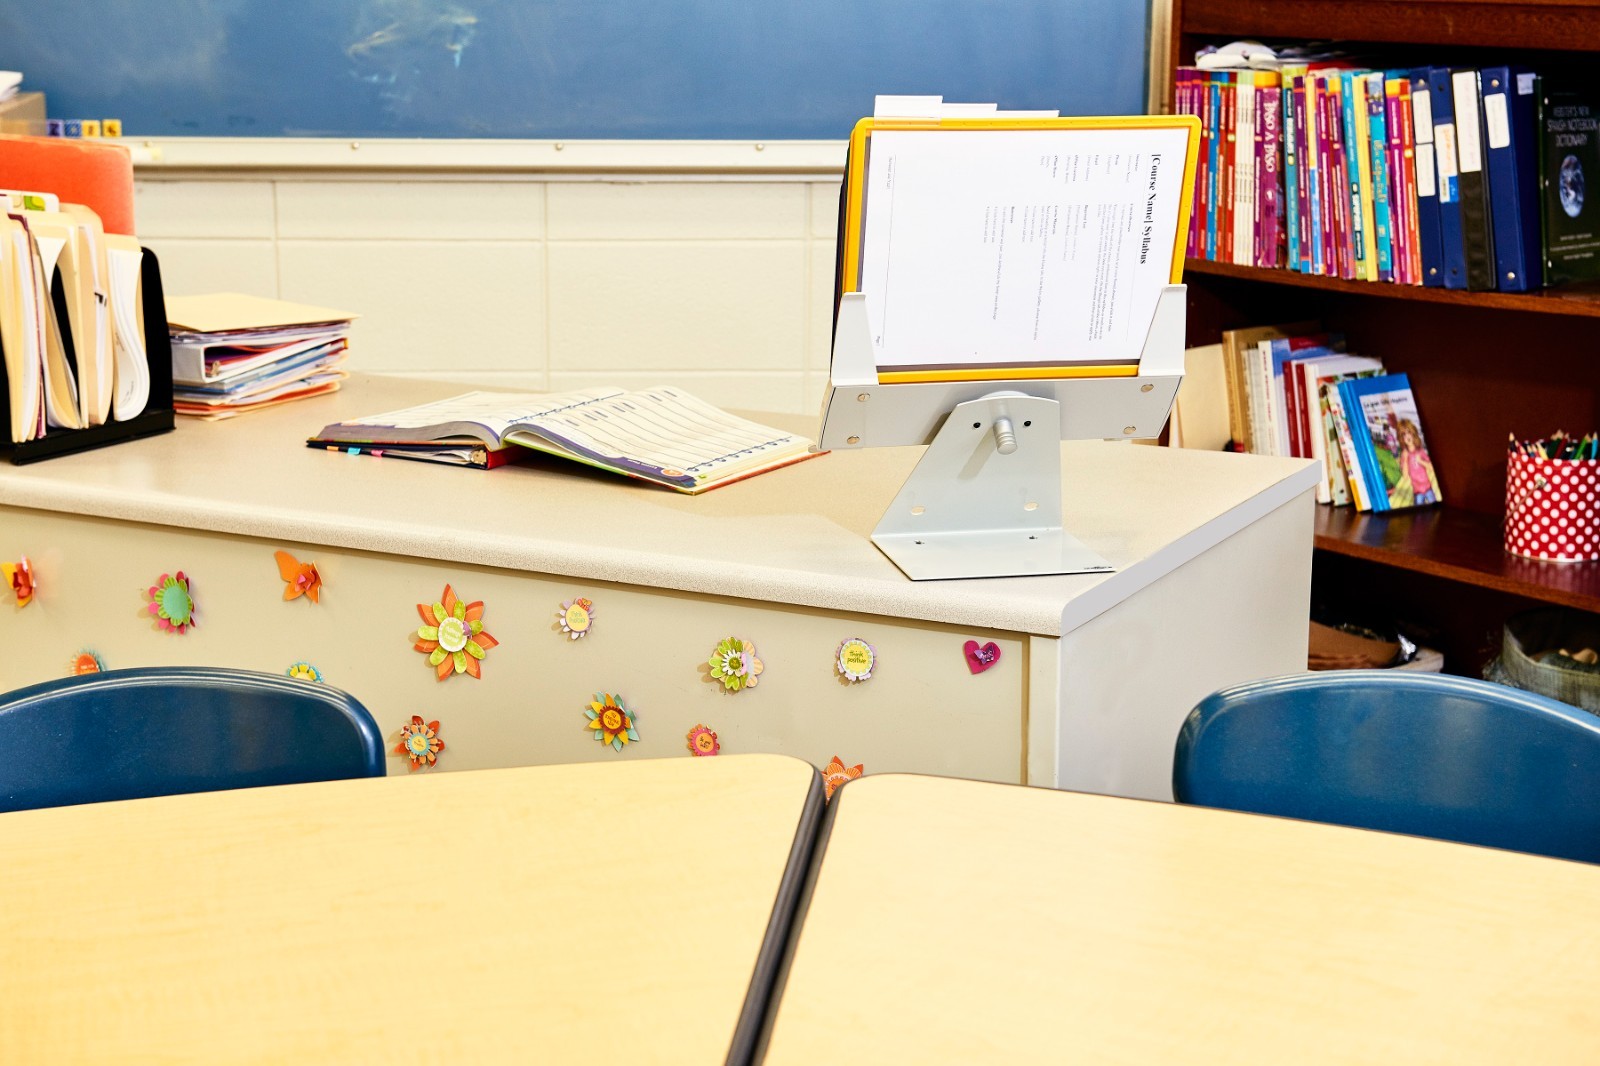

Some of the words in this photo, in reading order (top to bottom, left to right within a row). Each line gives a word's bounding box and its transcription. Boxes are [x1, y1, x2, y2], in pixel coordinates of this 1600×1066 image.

[1263, 100, 1278, 130] PASO
[1264, 131, 1275, 141] A
[1263, 142, 1277, 173] PASO
[1143, 193, 1157, 223] Name]
[1140, 225, 1153, 265] Syllabus
